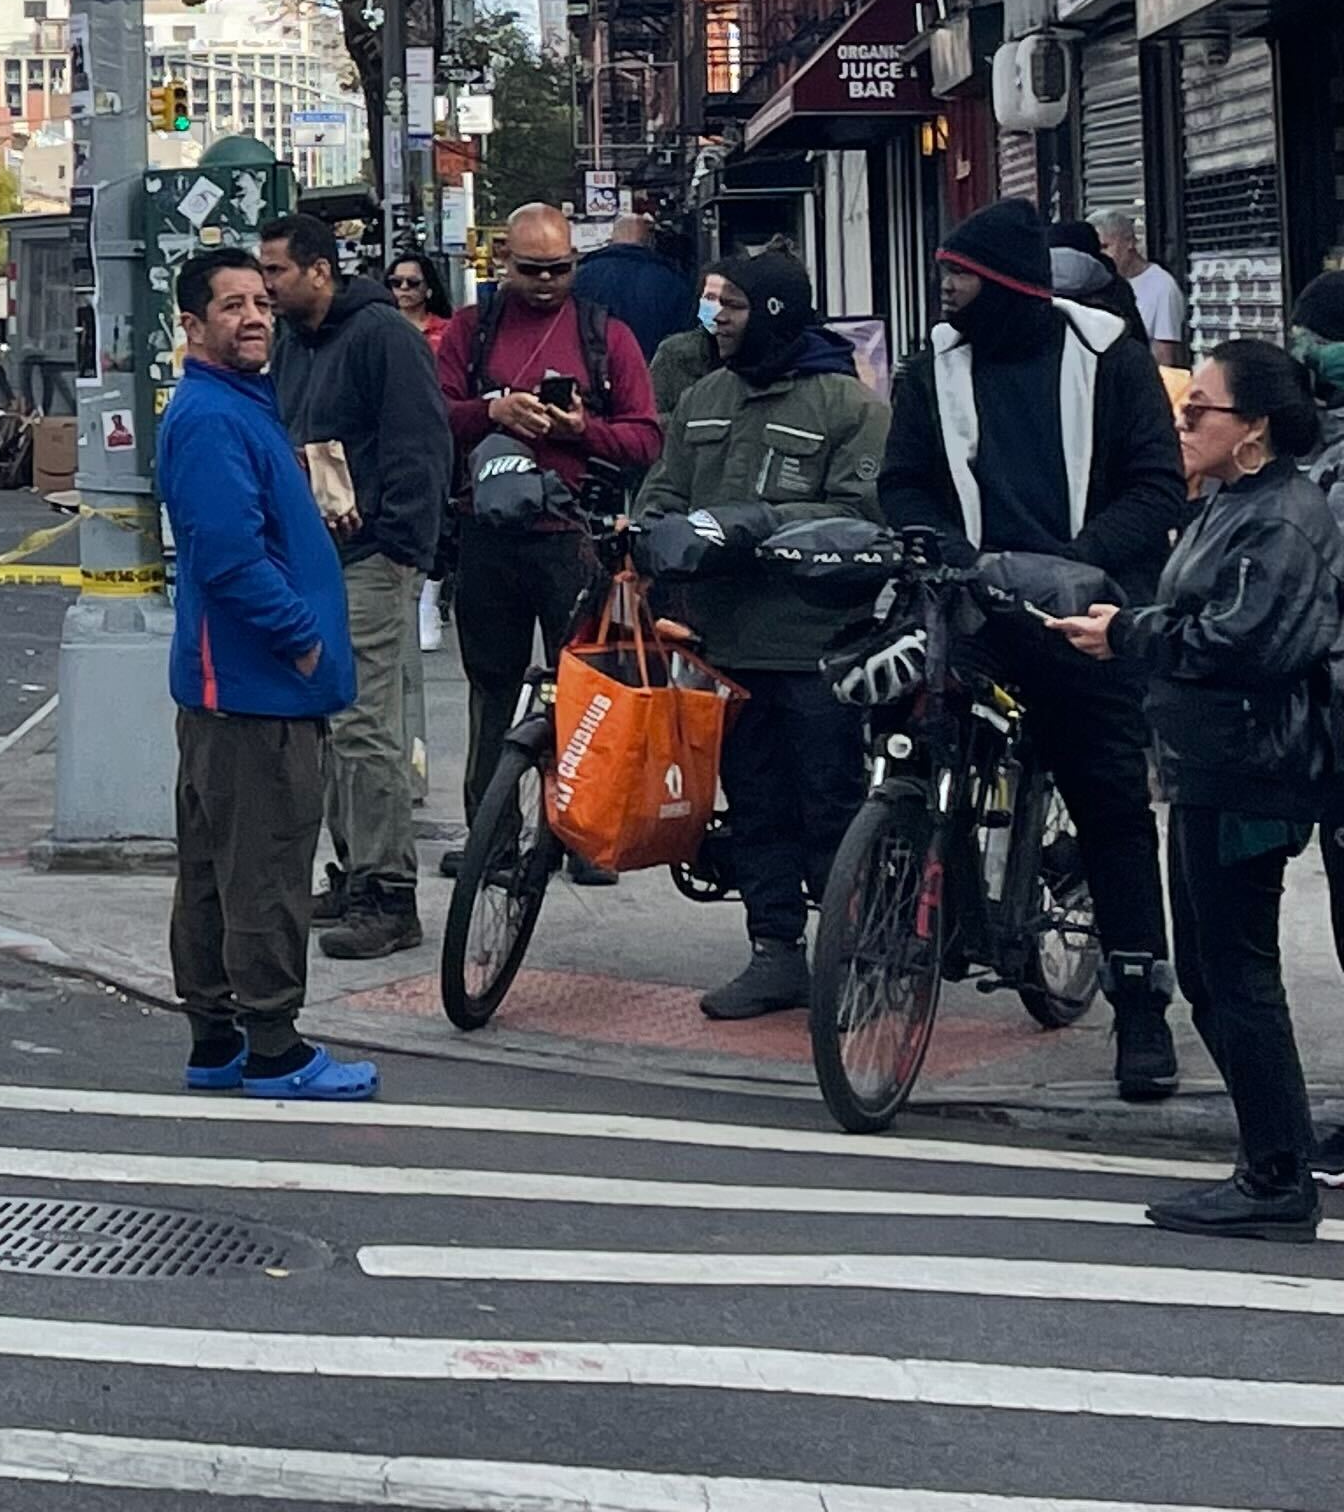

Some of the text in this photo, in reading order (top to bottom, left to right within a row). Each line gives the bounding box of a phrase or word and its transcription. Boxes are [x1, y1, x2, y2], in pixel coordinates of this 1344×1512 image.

[838, 62, 904, 79] JUICE
[849, 81, 896, 98] BAR
[558, 694, 612, 779] GRUBHUB
